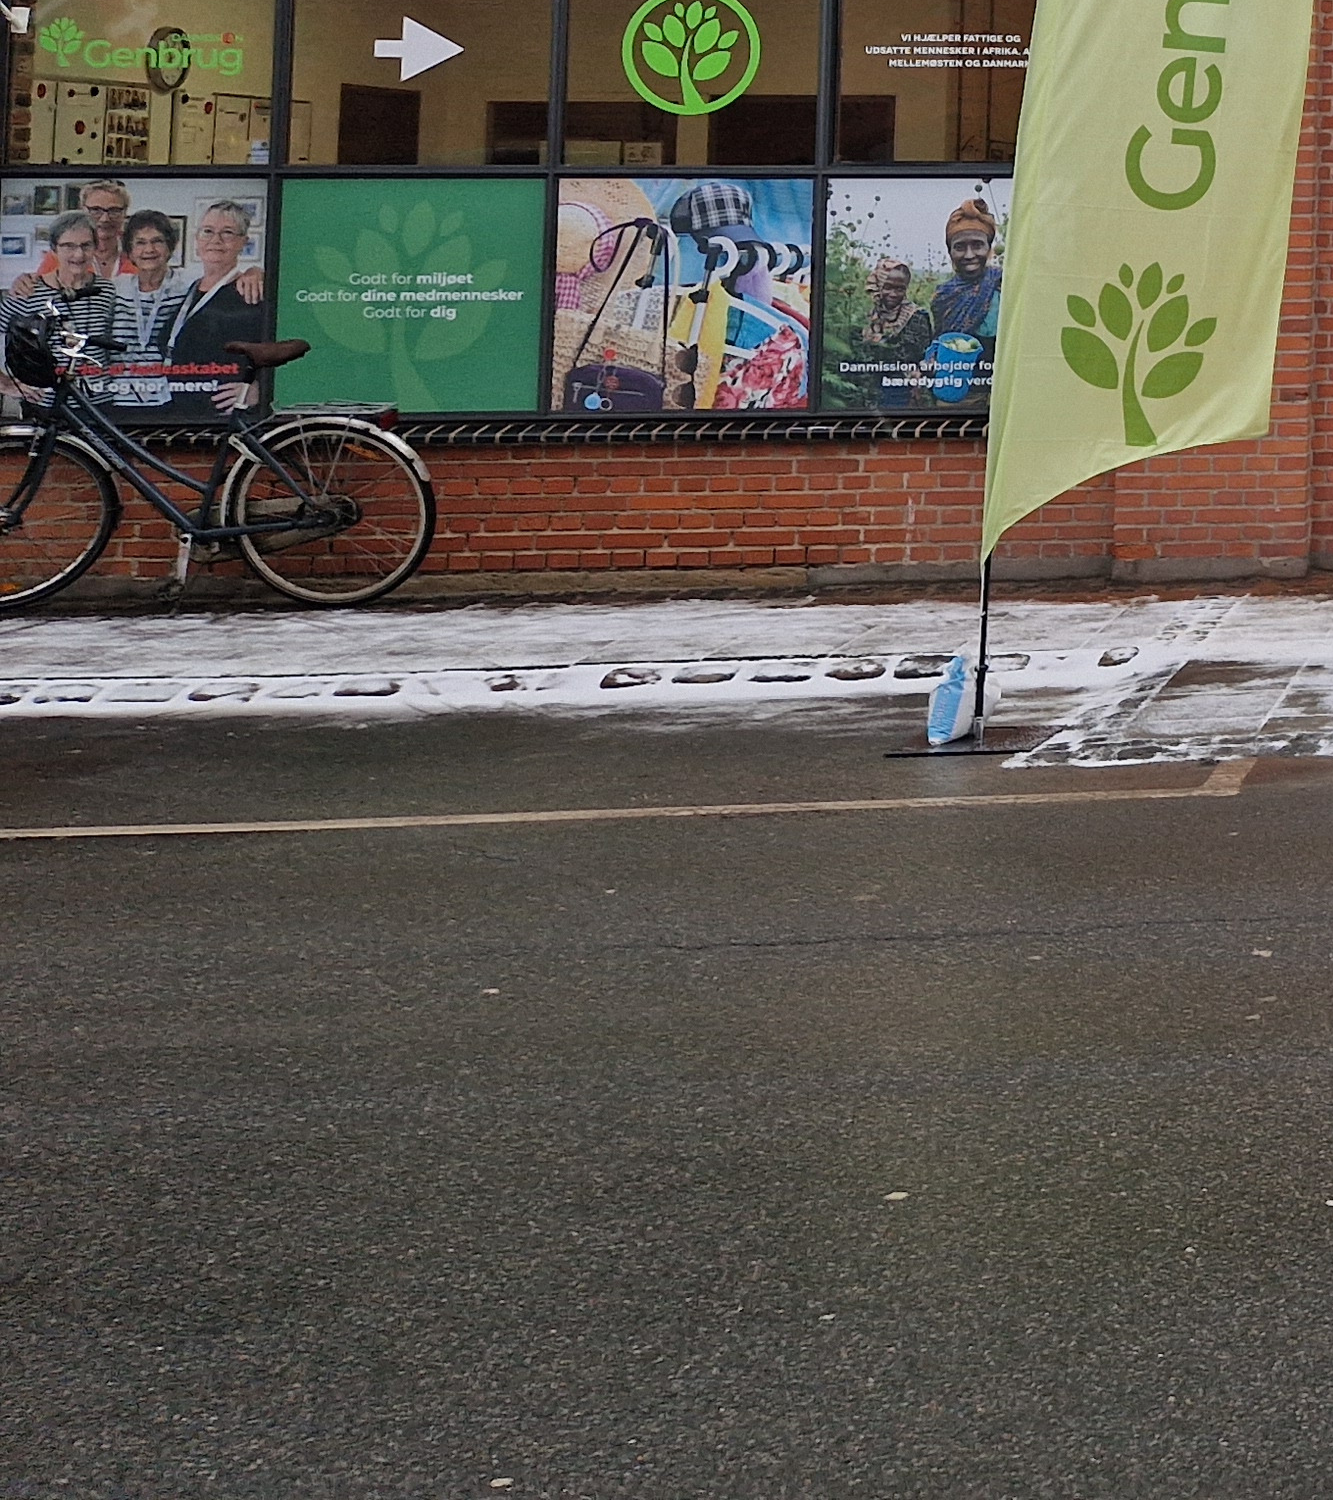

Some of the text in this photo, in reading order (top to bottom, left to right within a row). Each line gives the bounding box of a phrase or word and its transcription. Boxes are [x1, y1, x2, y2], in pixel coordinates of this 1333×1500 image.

[901, 33, 1021, 43] VI HJÆLPER FATTIGE OG
[865, 45, 912, 55] UDSATTE
[914, 45, 975, 55] MENNESKER
[83, 38, 244, 77] Genbrug
[888, 58, 963, 68] MELLEMØSTEN
[965, 59, 981, 67] OG
[349, 272, 473, 287] Godt for miljøet
[296, 289, 524, 302] Godt for dine medmennesker
[363, 305, 457, 321] Godt for dig
[839, 360, 917, 373] Danmission
[919, 360, 976, 373] arbejder
[169, 379, 219, 392] mere!
[882, 375, 963, 389] bæredygtig
